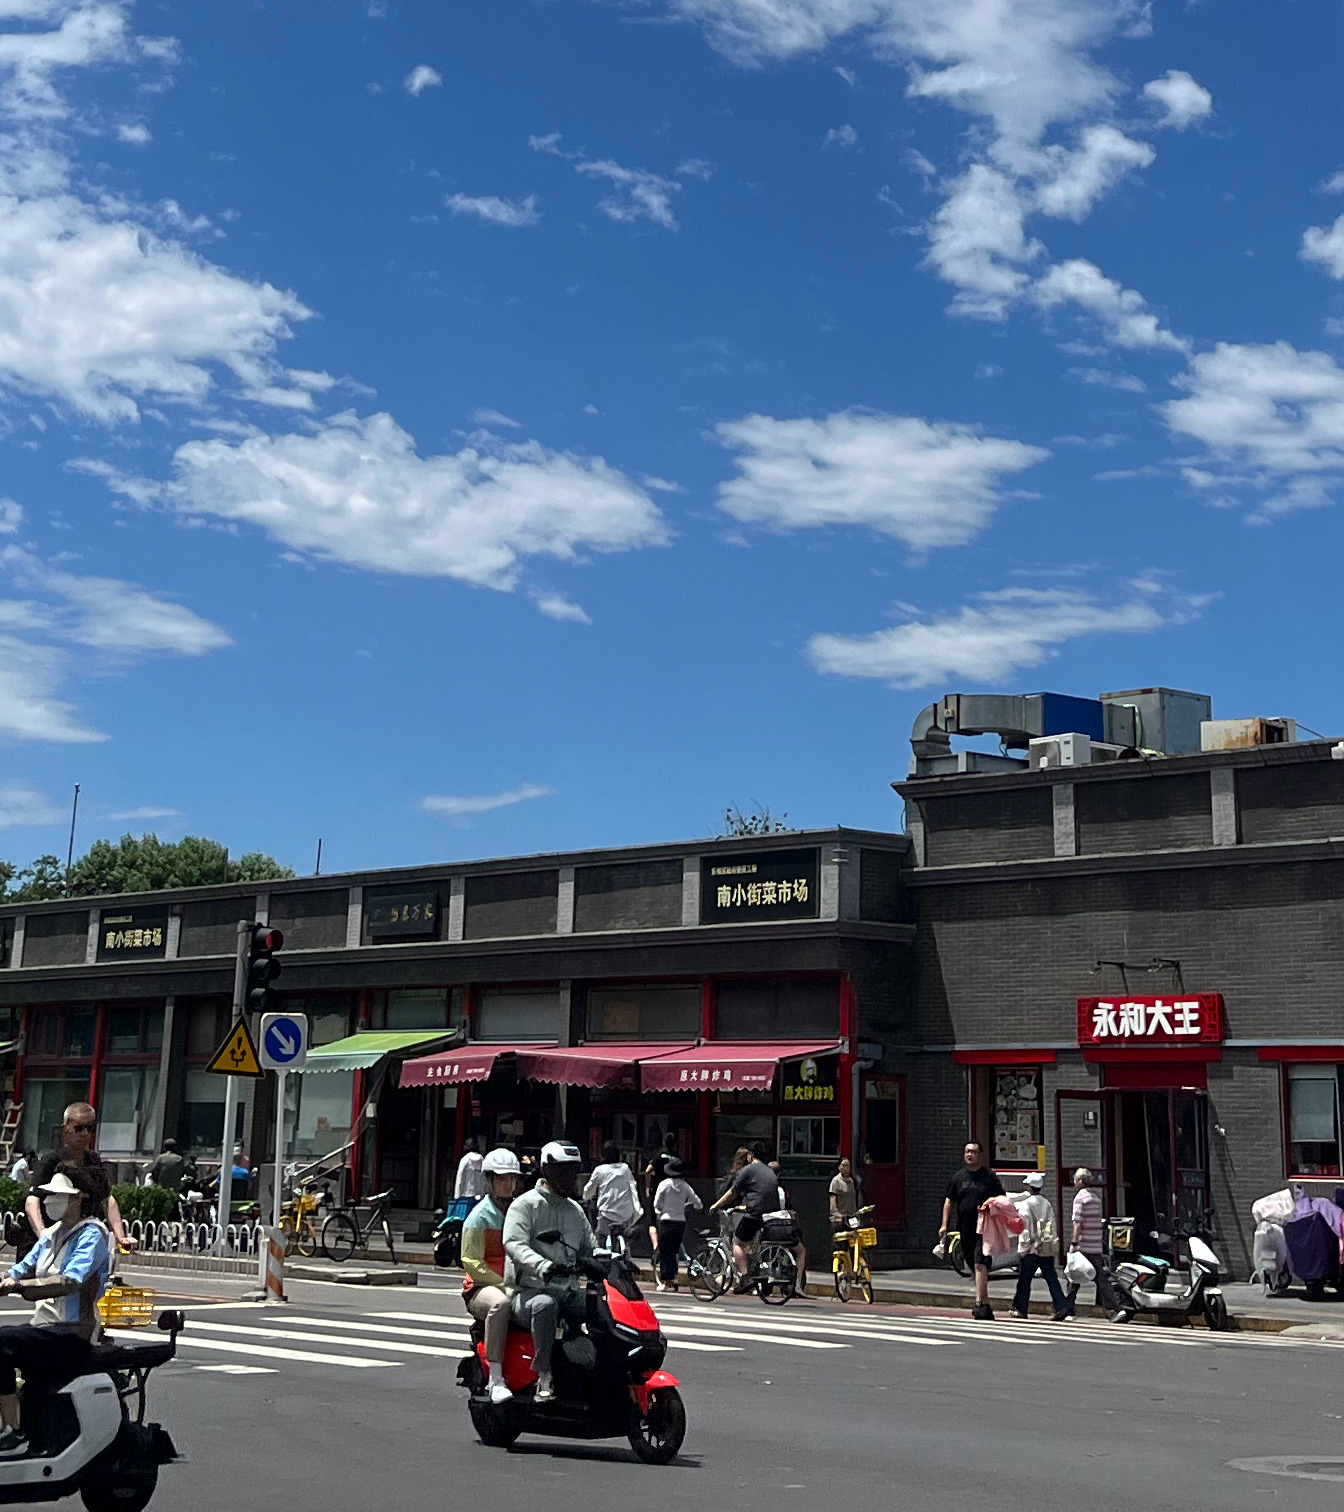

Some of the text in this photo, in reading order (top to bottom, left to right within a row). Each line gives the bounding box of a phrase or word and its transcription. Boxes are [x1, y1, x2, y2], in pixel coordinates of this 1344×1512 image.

[717, 878, 808, 907] 南小街菜市场
[105, 927, 162, 949] 南小街菜市场
[1092, 1000, 1201, 1037] 永和大王
